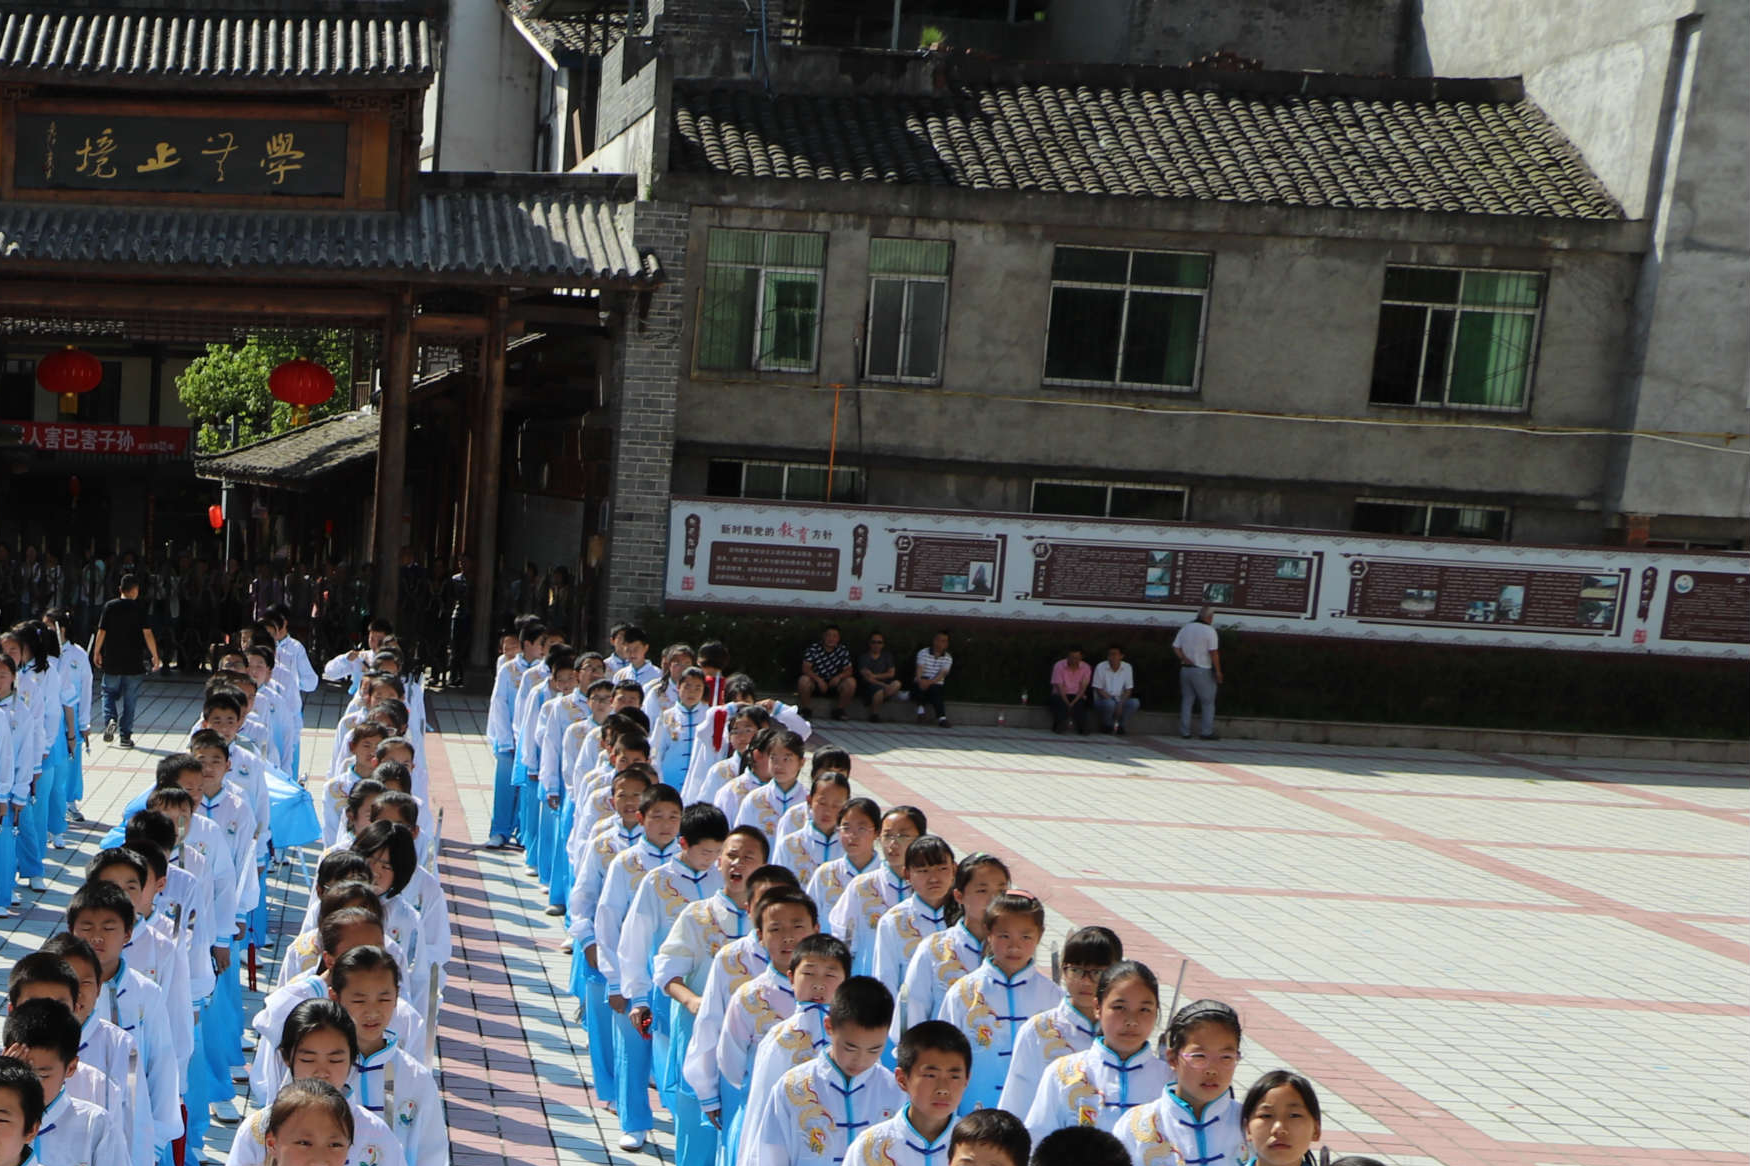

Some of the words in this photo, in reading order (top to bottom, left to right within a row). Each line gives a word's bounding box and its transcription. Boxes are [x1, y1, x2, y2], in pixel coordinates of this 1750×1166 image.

[19, 426, 135, 453] 人害已害子孙
